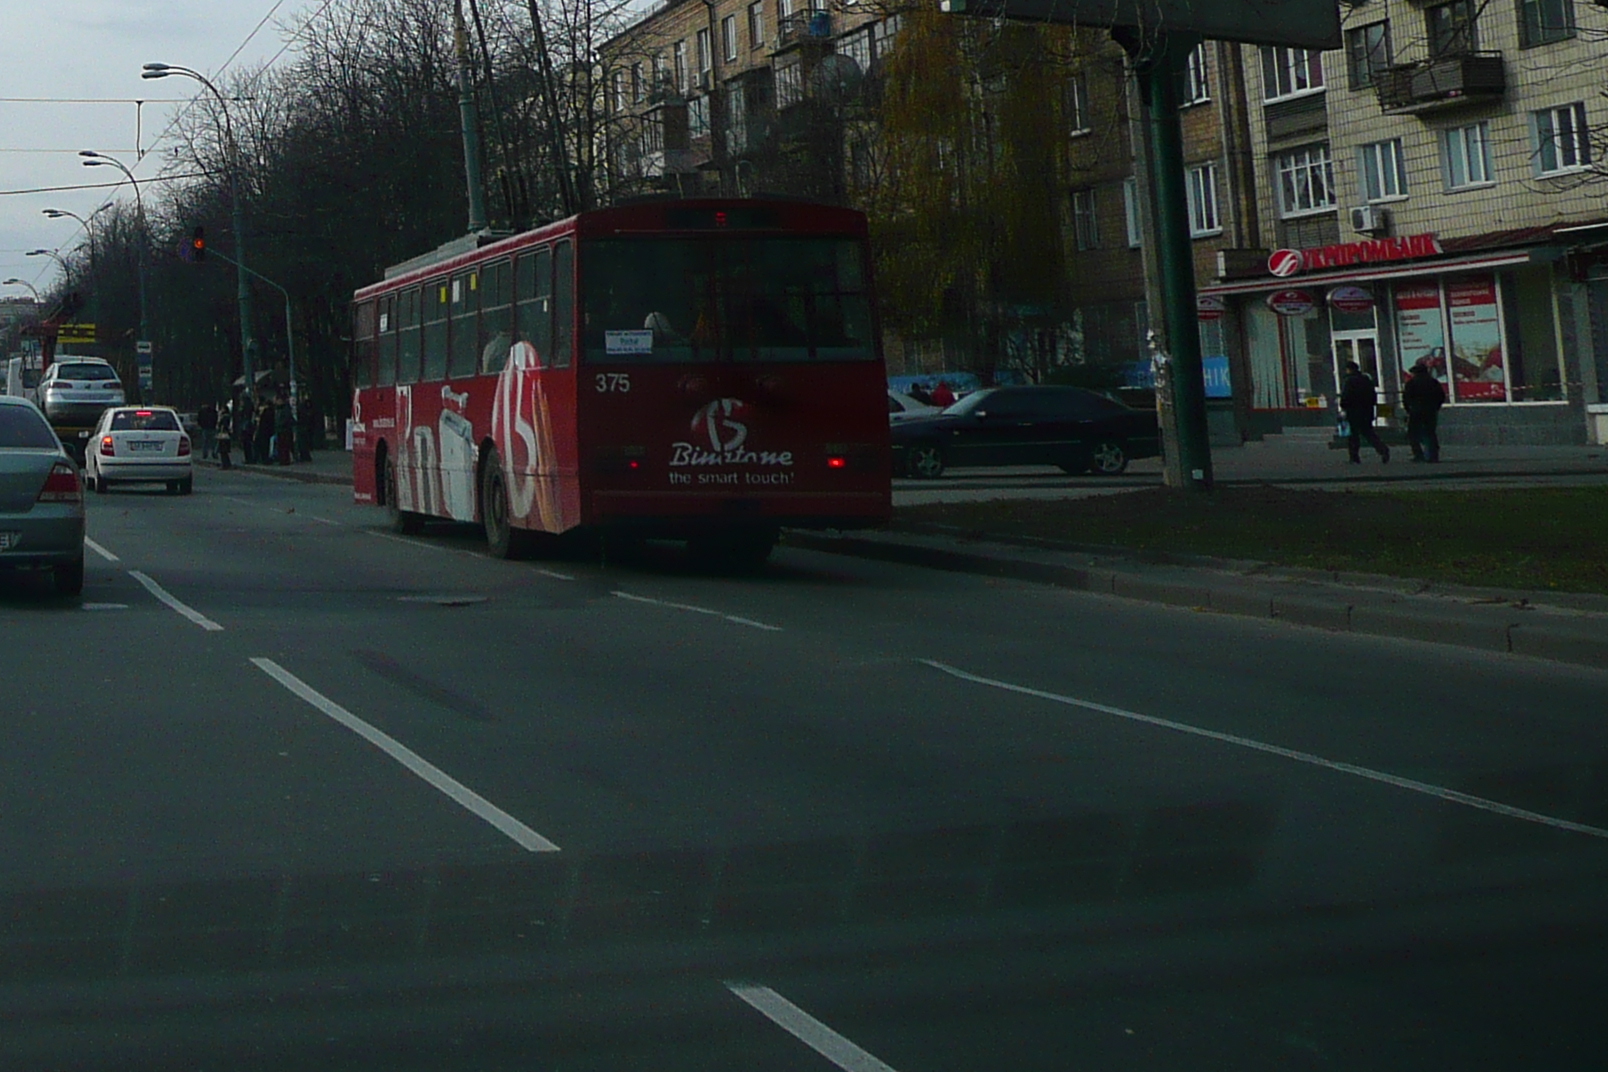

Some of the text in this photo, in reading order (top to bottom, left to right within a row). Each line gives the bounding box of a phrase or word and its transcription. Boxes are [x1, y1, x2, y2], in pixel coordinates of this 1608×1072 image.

[1303, 232, 1443, 270] УКРПРОМБАНК
[595, 372, 631, 393] 375
[668, 470, 795, 485] the smart touch!
